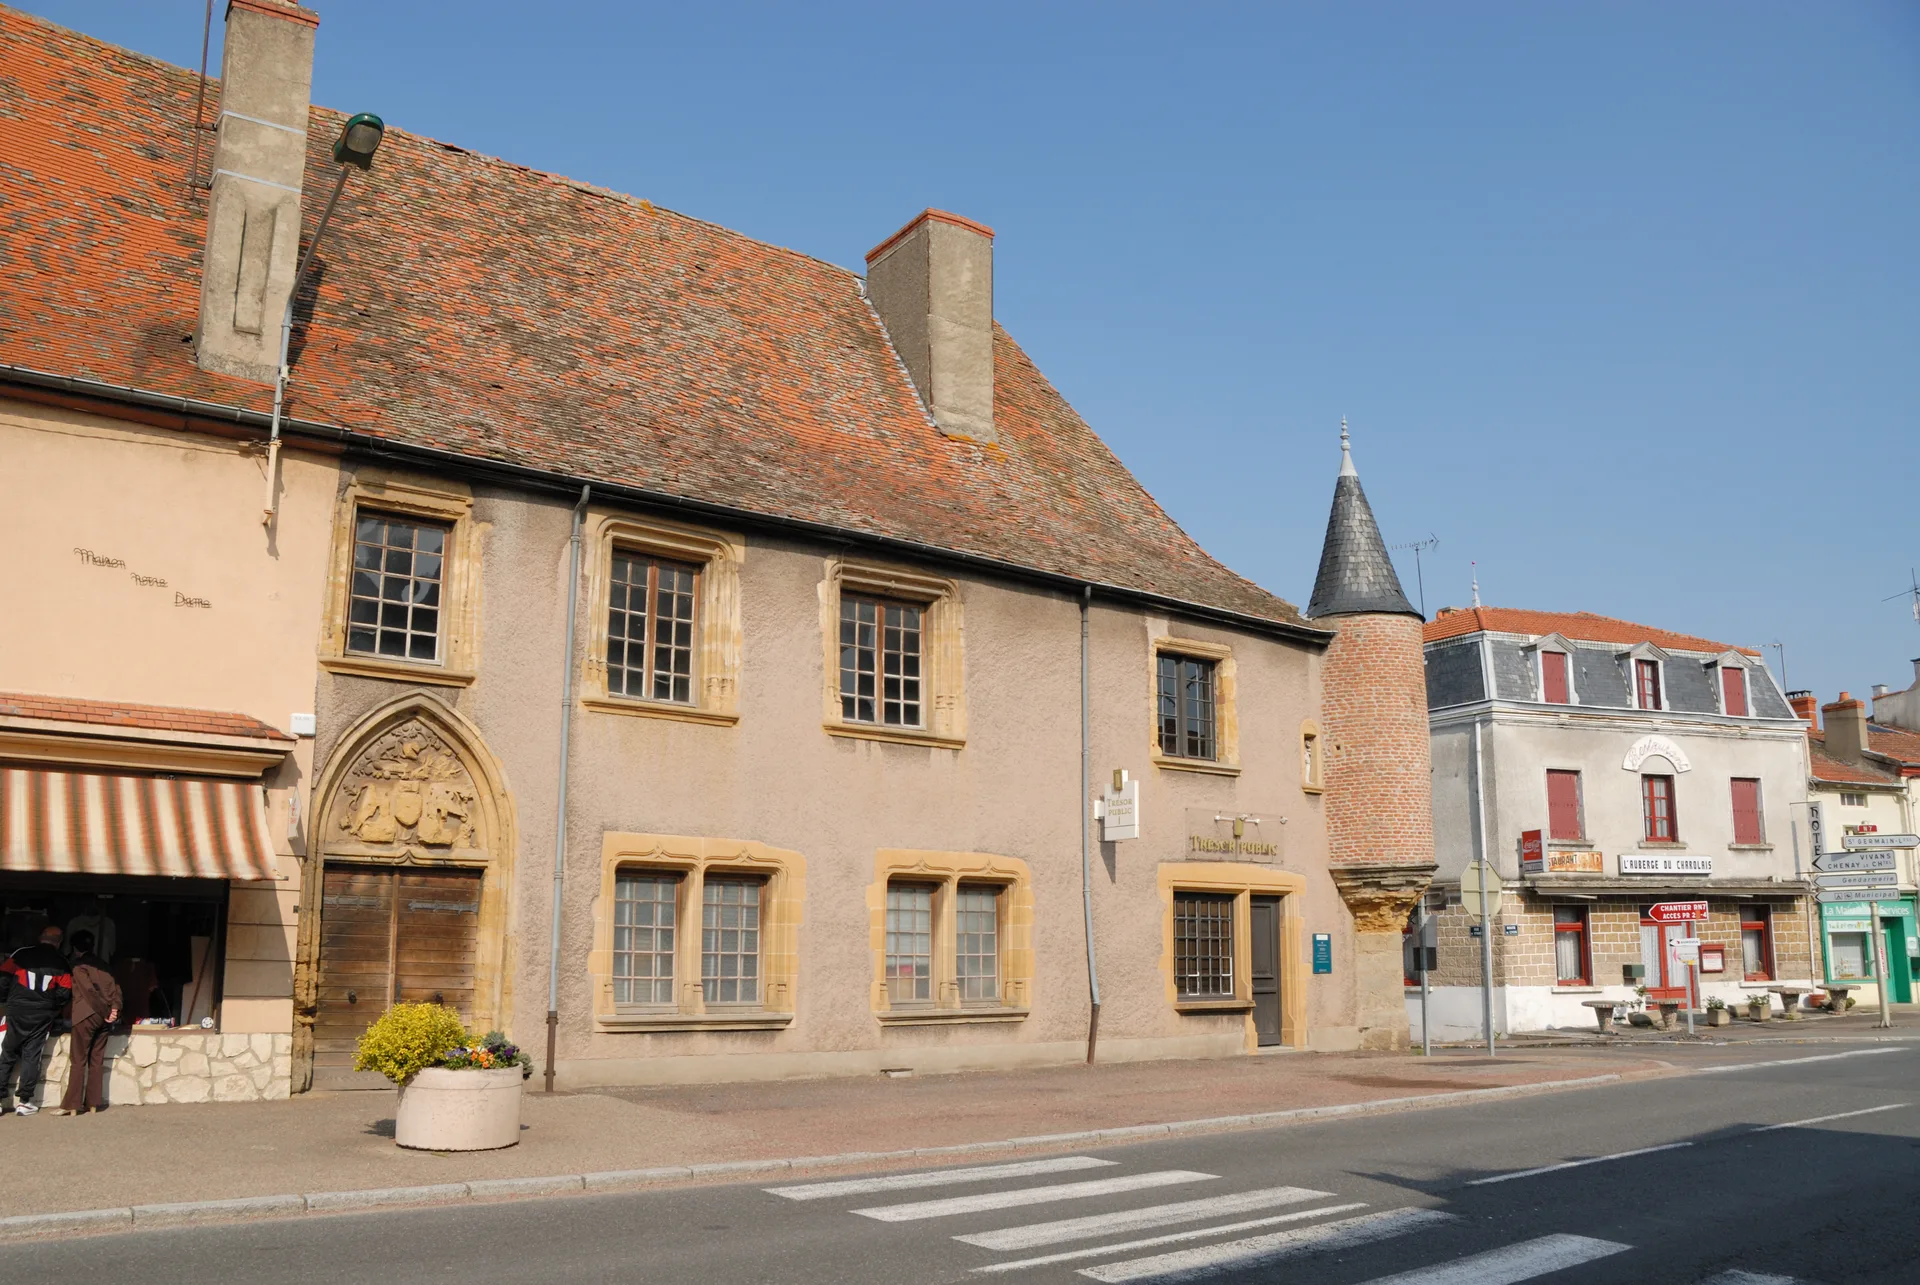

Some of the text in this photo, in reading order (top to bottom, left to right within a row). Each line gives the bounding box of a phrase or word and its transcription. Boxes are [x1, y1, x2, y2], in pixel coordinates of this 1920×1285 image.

[175, 591, 212, 608] Dame
[1810, 806, 1821, 856] HOTE
[1624, 860, 1712, 870] L'AUBERGE DU CHAROLAIS
[1824, 905, 1834, 915] La
[1879, 905, 1910, 915] Services
